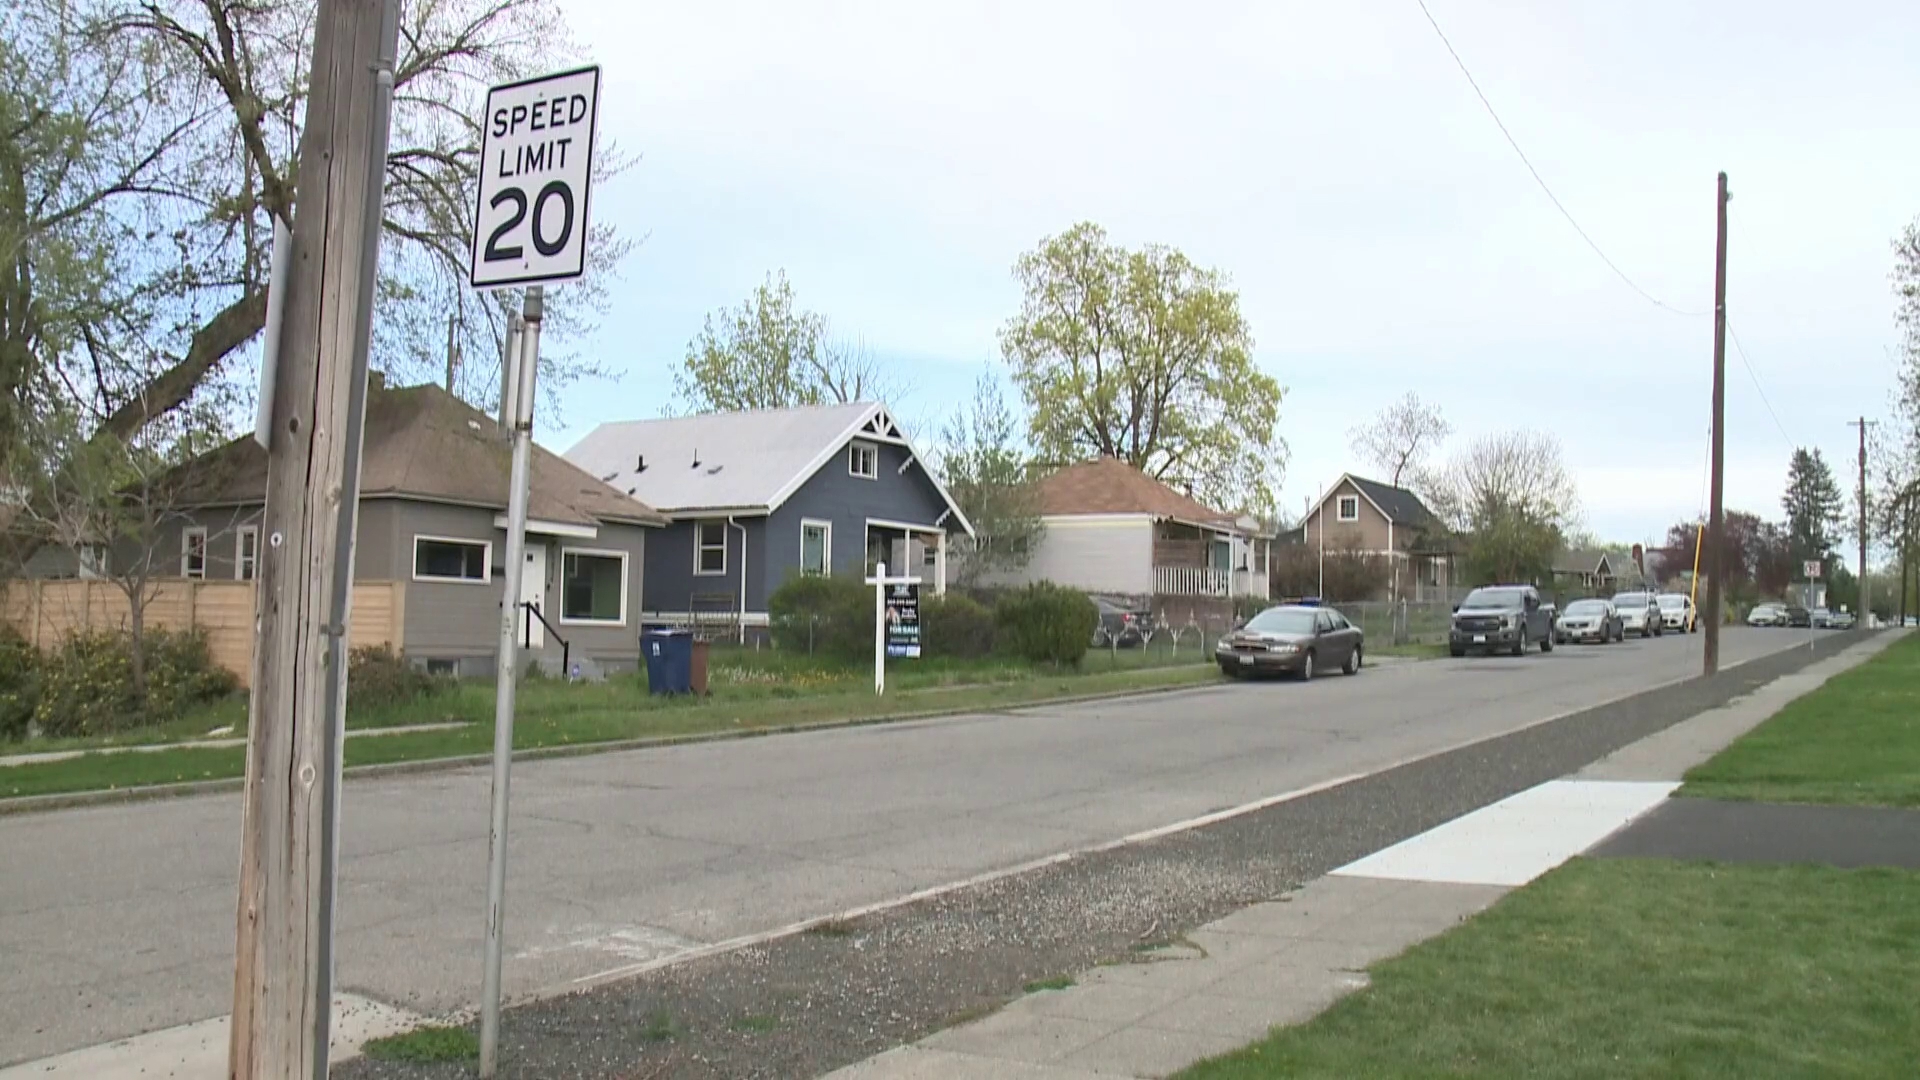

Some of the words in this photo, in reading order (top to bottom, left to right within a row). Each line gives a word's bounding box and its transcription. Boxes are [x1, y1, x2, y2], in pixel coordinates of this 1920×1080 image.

[492, 93, 587, 138] SPEED
[499, 138, 572, 178] LIMIT
[484, 180, 575, 262] 20
